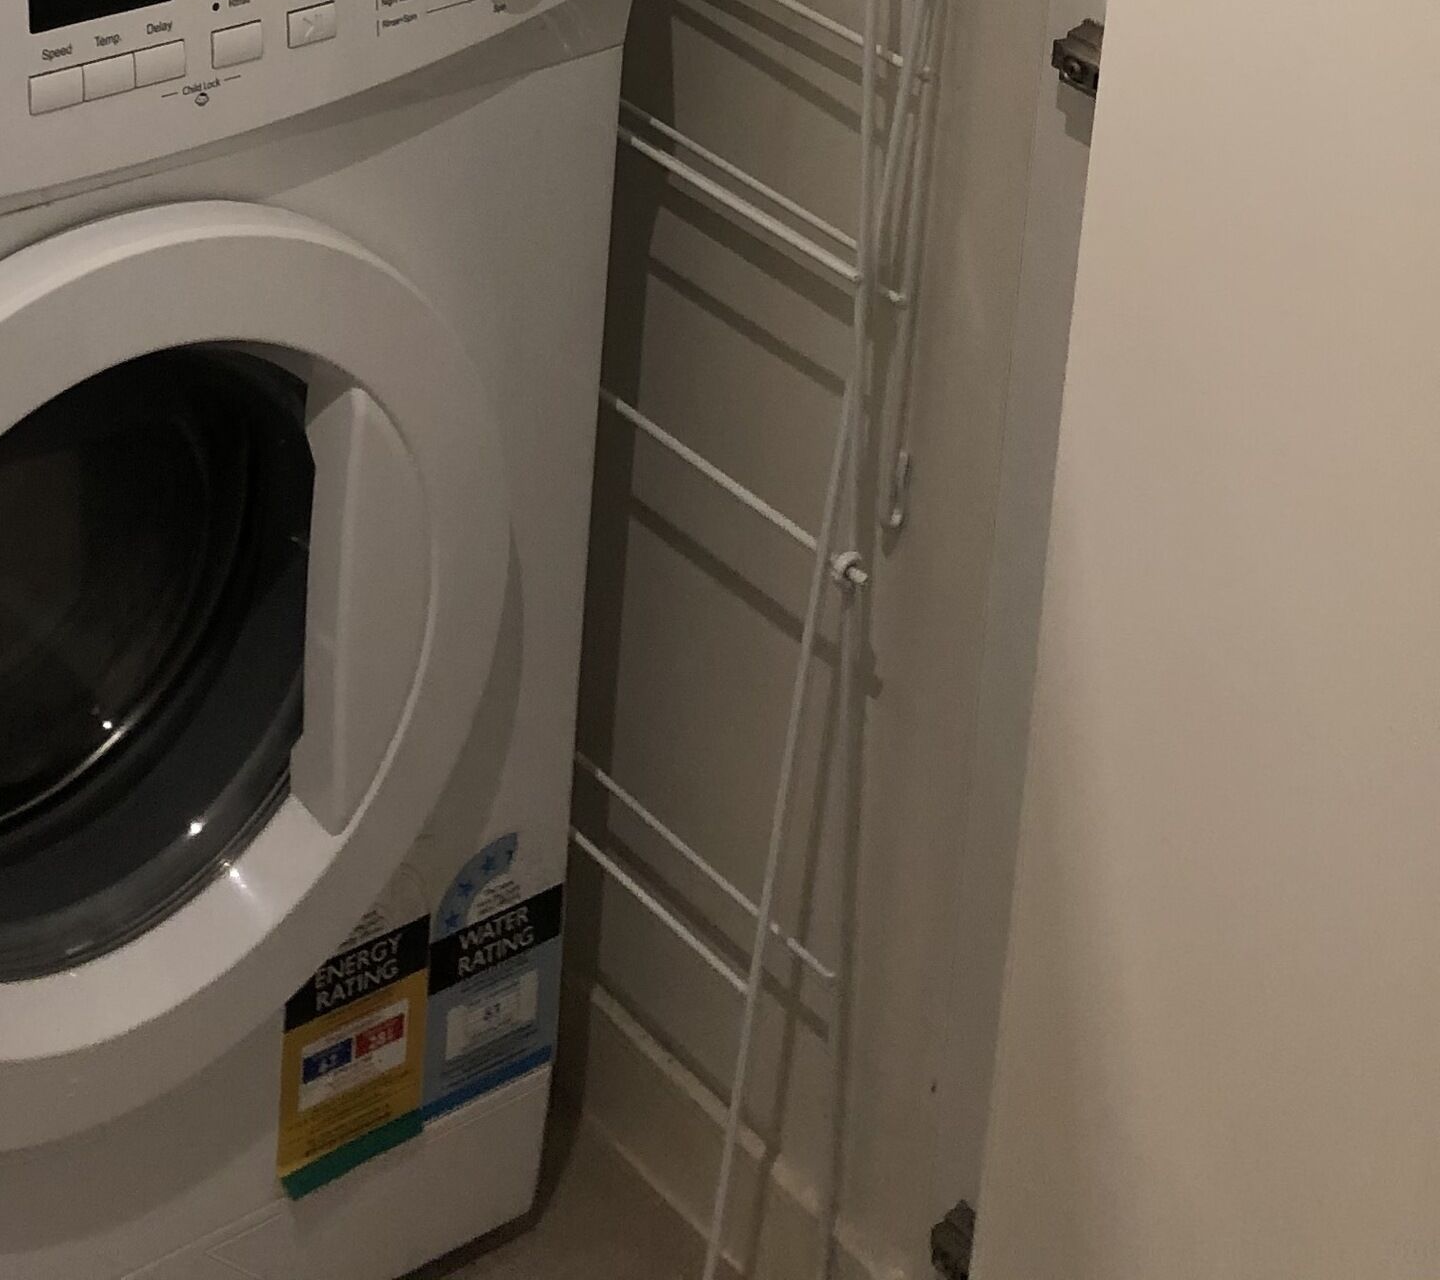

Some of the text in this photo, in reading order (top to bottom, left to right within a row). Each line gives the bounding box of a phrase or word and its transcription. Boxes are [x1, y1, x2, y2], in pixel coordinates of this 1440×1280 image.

[94, 33, 122, 50] Temp.
[146, 20, 172, 36] Delay
[41, 43, 73, 62] Speed
[182, 77, 221, 96] Child Lock
[459, 906, 529, 951] WATER
[314, 933, 402, 990] ENERGY
[458, 926, 534, 977] RATING
[315, 958, 400, 1013] RATING
